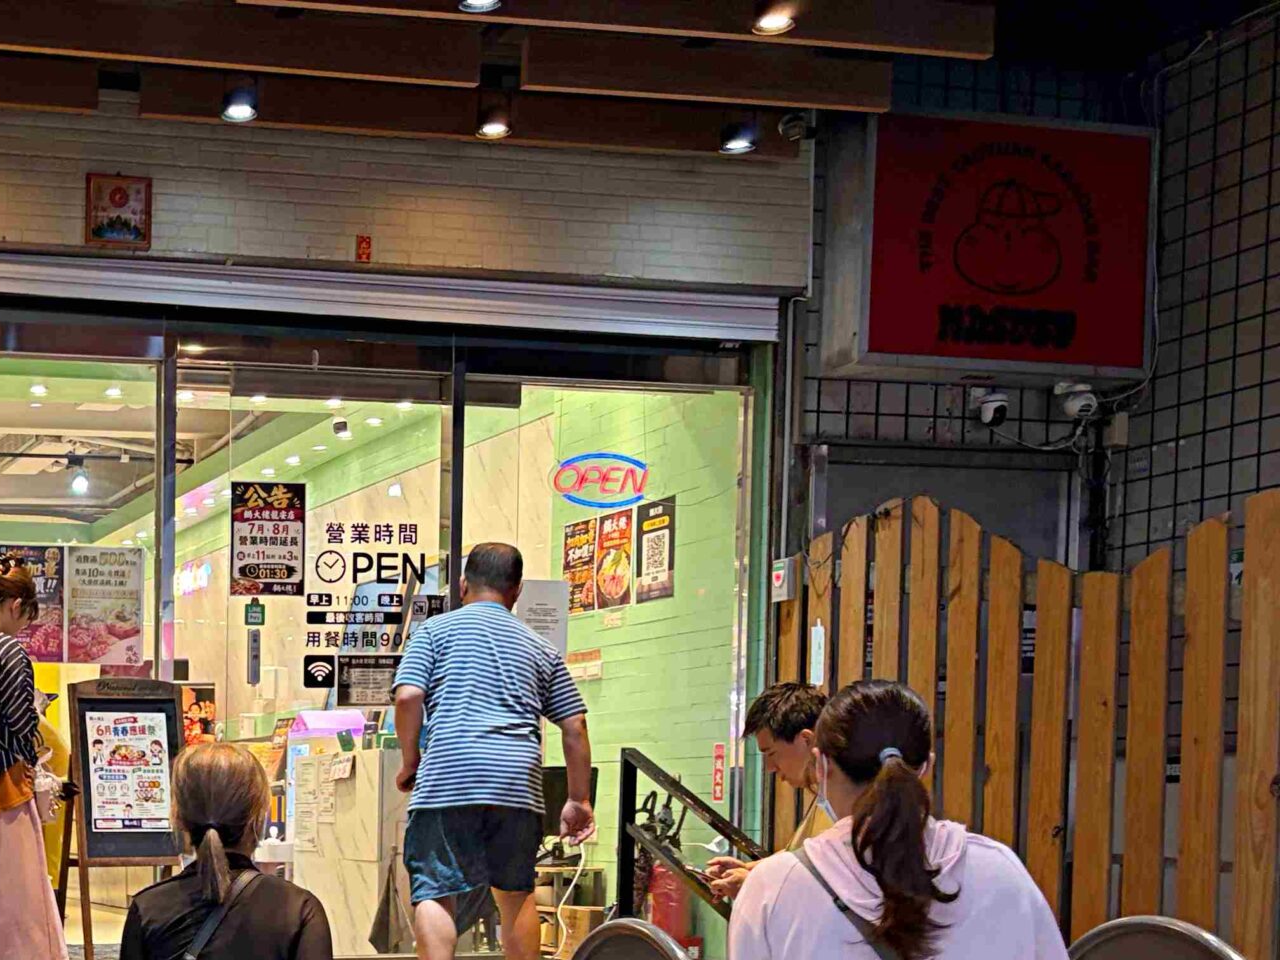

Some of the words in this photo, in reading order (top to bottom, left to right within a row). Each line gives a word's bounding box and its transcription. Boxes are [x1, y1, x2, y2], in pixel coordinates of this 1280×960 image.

[554, 464, 648, 494] OPEN
[244, 484, 292, 508] 公告
[326, 522, 418, 545] 營業時間
[239, 535, 299, 547] 營業時間延長
[259, 569, 288, 578] 01:30
[309, 596, 330, 605] 早上
[336, 596, 369, 606] 11:00
[380, 595, 401, 605] 晚上
[325, 613, 384, 623] 最後收客時間
[306, 631, 411, 648] 用餐時間90
